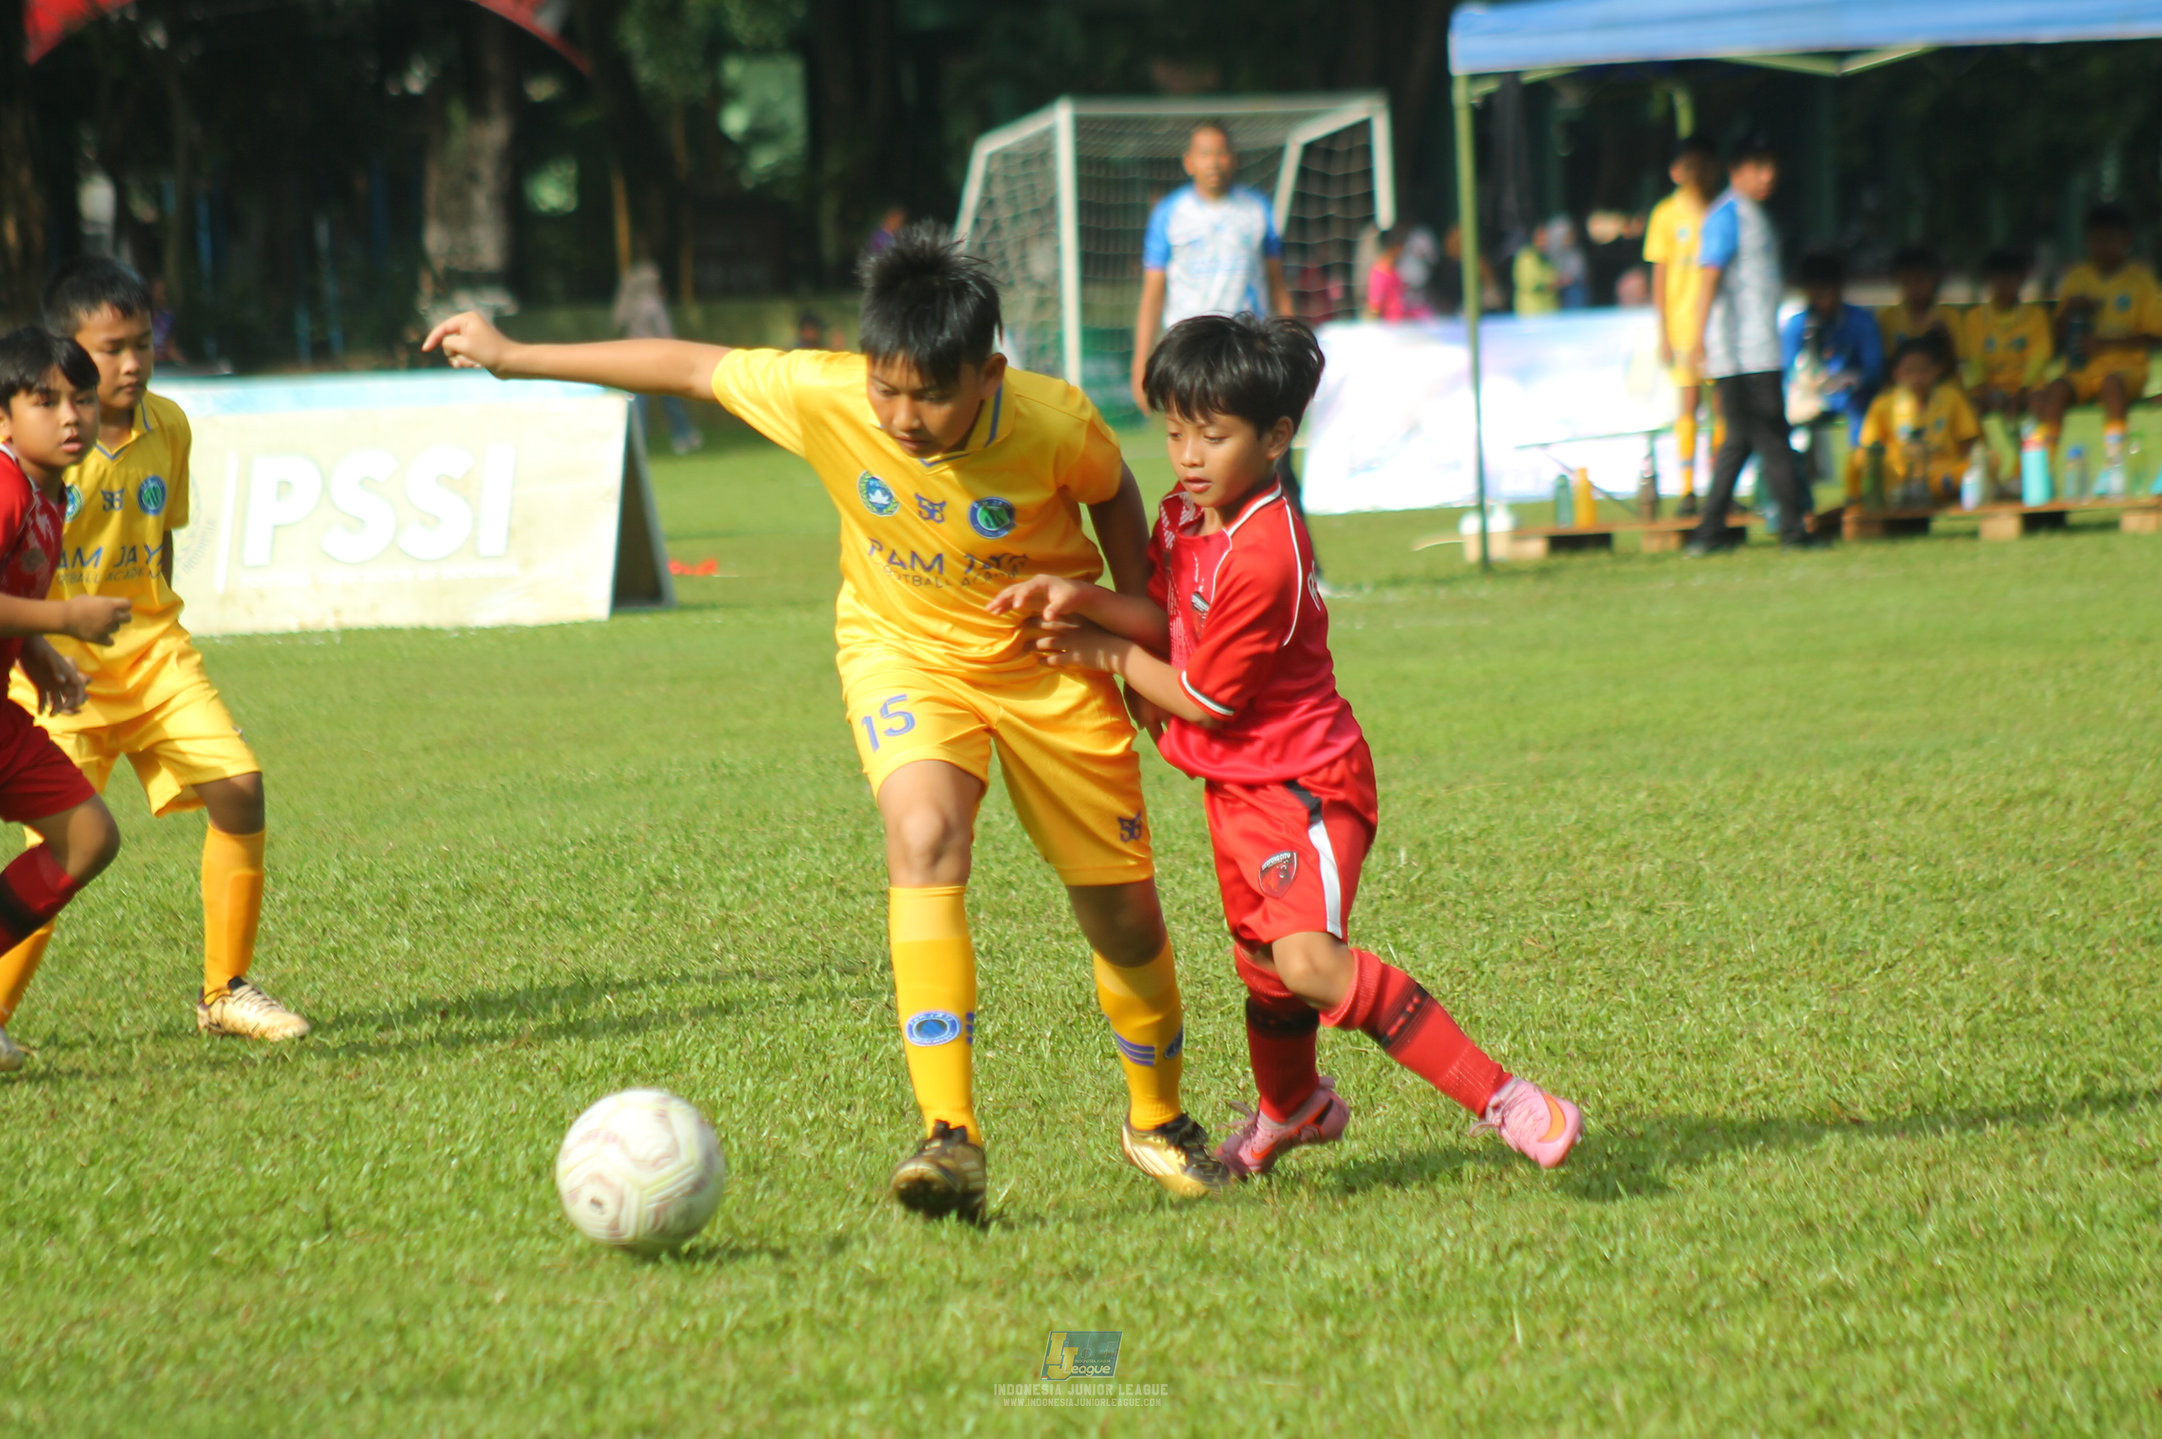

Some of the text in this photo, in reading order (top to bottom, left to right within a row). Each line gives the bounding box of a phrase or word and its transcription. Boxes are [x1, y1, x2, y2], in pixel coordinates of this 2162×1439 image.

[243, 442, 516, 567] PSSI
[57, 547, 103, 569] AM
[868, 537, 945, 575] PAM
[861, 693, 916, 753] 15
